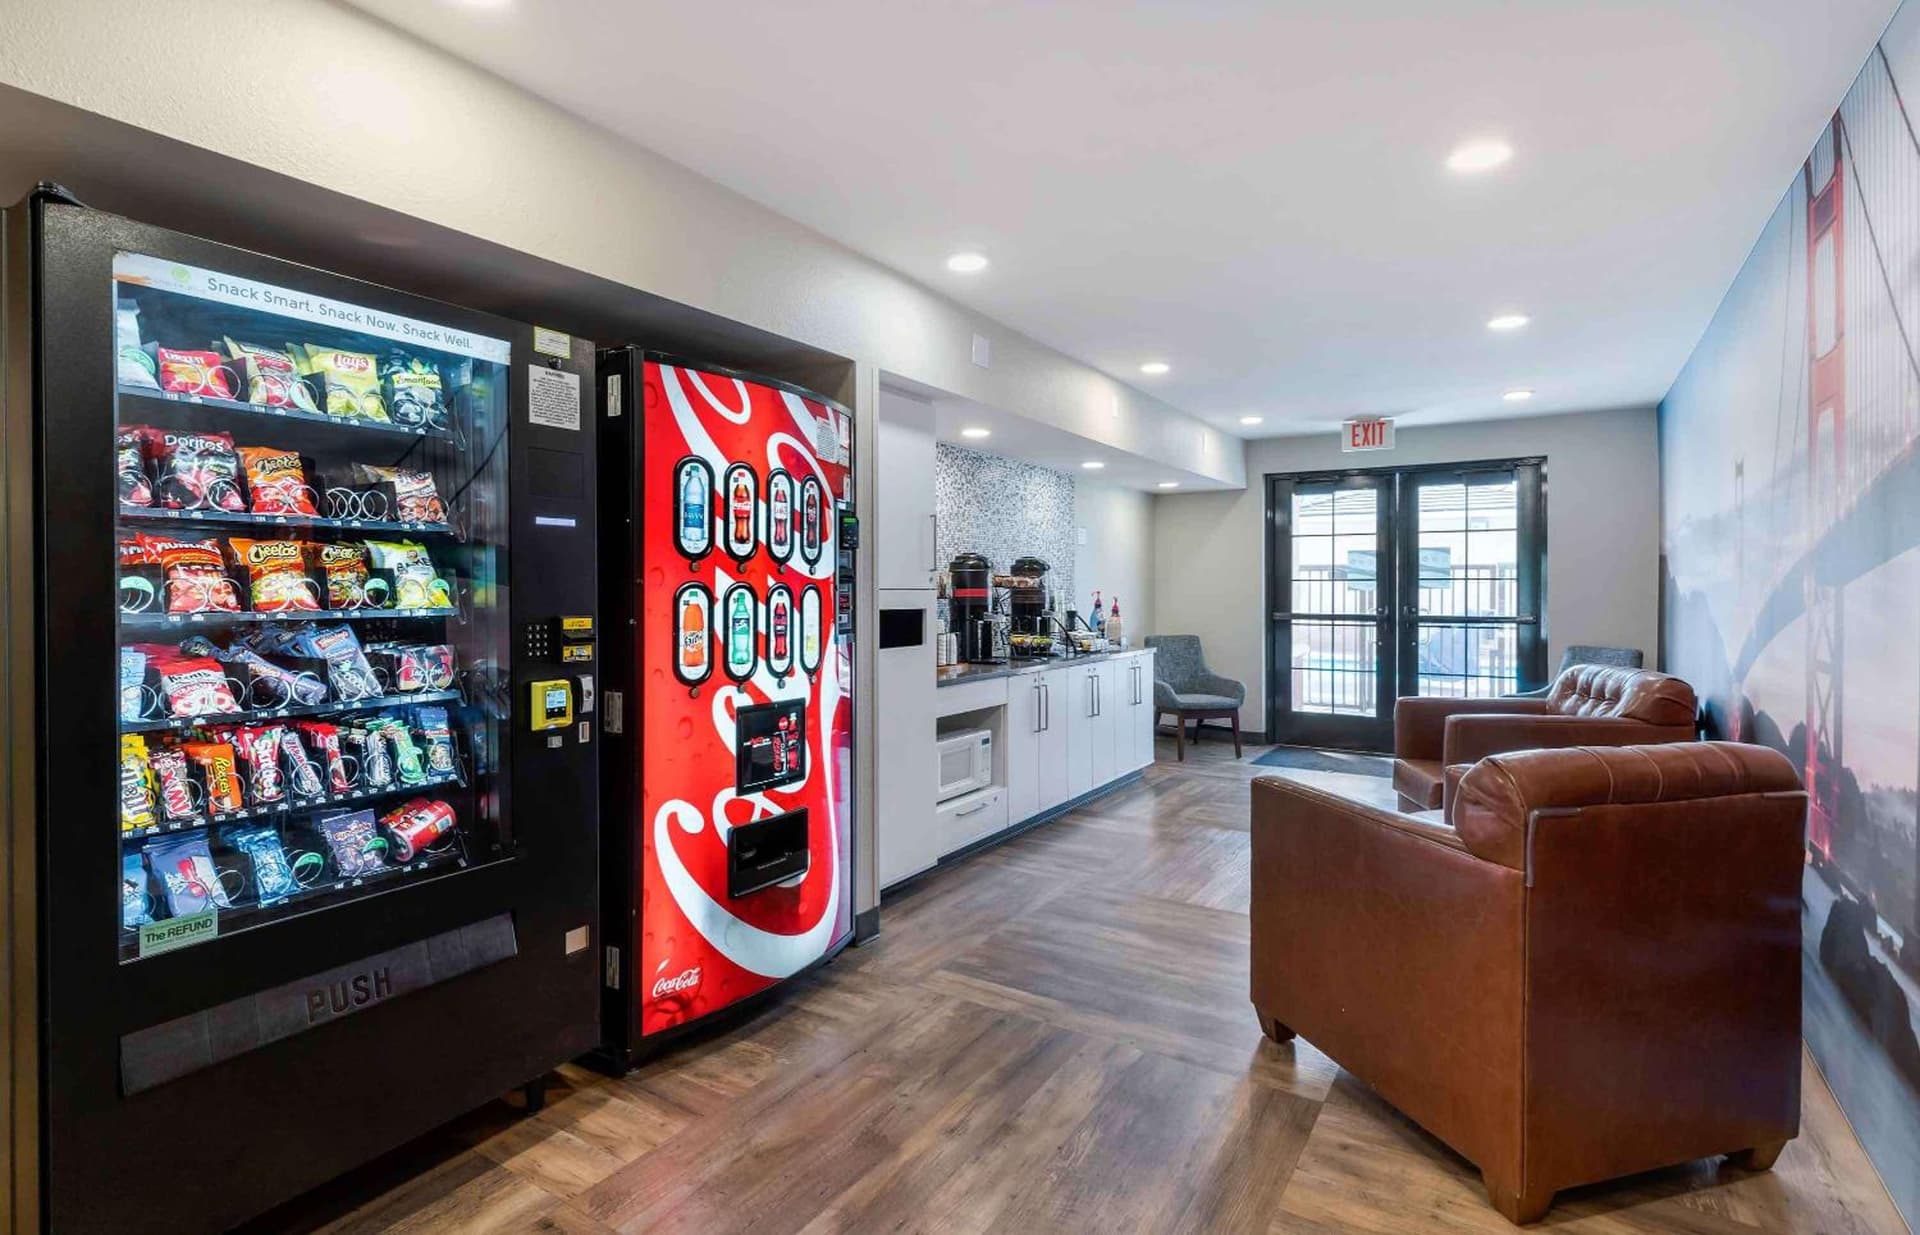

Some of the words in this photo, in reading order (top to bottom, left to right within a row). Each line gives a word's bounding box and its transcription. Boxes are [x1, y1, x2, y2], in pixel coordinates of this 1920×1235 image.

[207, 277, 259, 301] Snack
[263, 291, 314, 313] Smart.
[319, 303, 362, 324] Snack
[366, 314, 400, 333] Now.
[402, 323, 441, 342] Snack
[443, 332, 473, 349] Well.
[164, 434, 225, 452] Doritos
[1352, 421, 1386, 447] EXIT
[255, 456, 302, 475] Cheetos
[248, 542, 298, 563] Cheetos
[320, 546, 362, 563] Cheetos
[145, 932, 166, 944] The
[167, 918, 213, 938] REFUND
[305, 967, 392, 1025] PUSH
